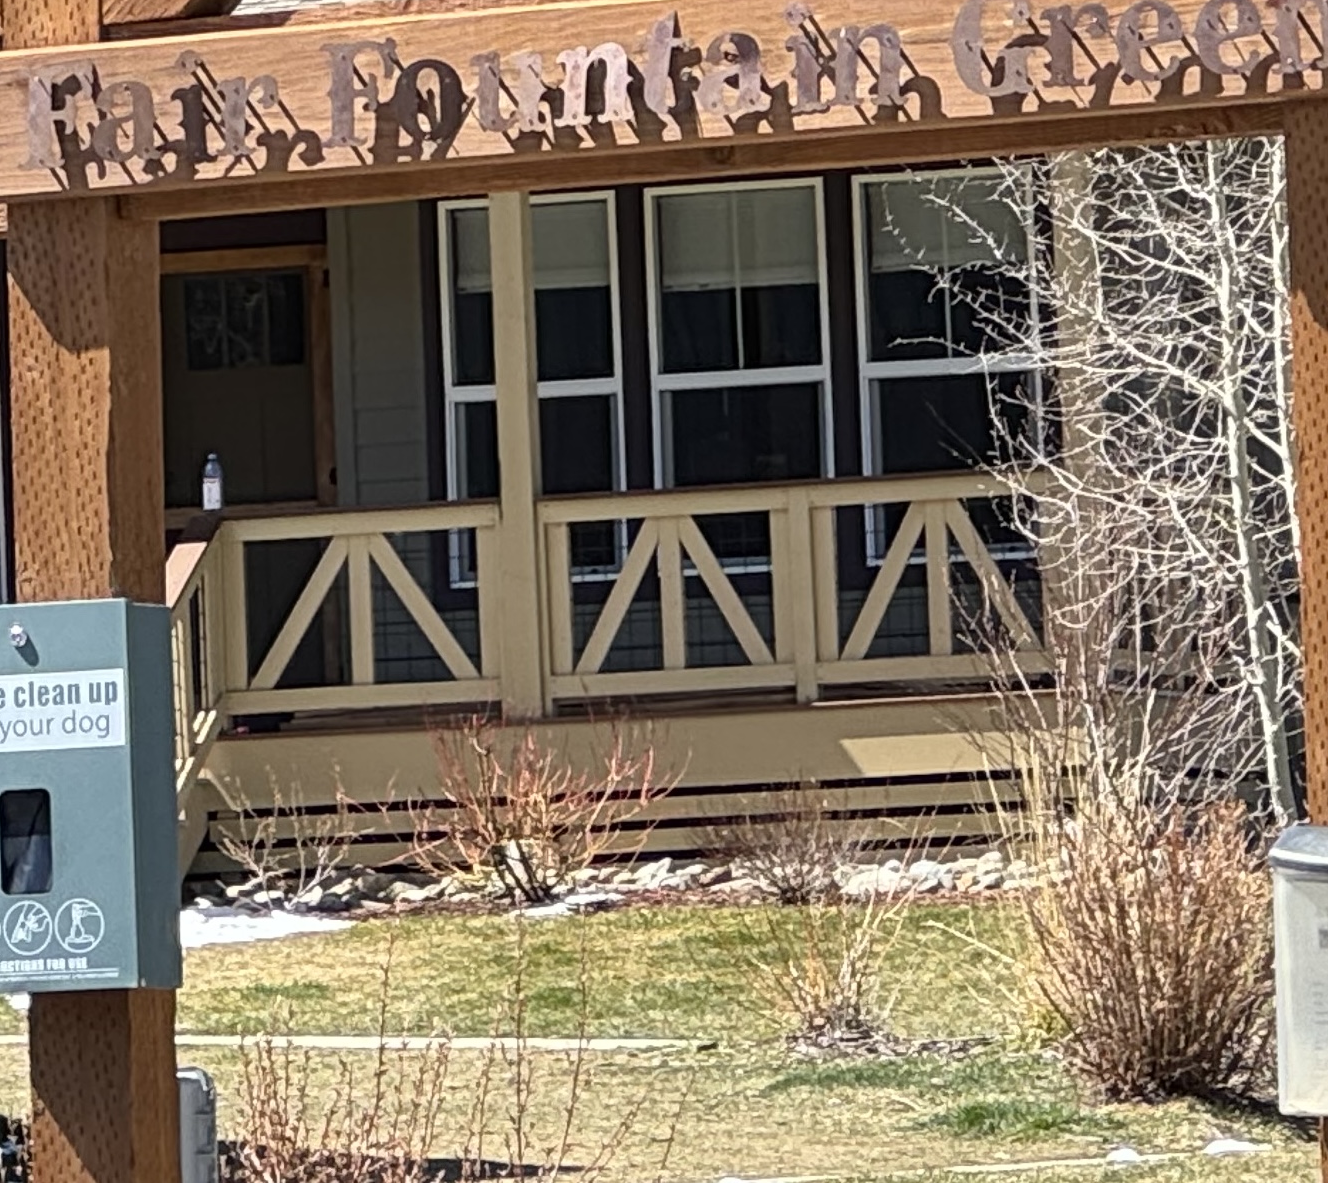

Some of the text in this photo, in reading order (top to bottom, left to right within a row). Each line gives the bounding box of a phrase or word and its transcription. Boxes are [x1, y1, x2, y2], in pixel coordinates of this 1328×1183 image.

[19, 49, 281, 169] Fair
[318, 1, 909, 149] Fountain
[13, 680, 81, 709] clean
[88, 680, 118, 706] up
[61, 709, 111, 739] dog
